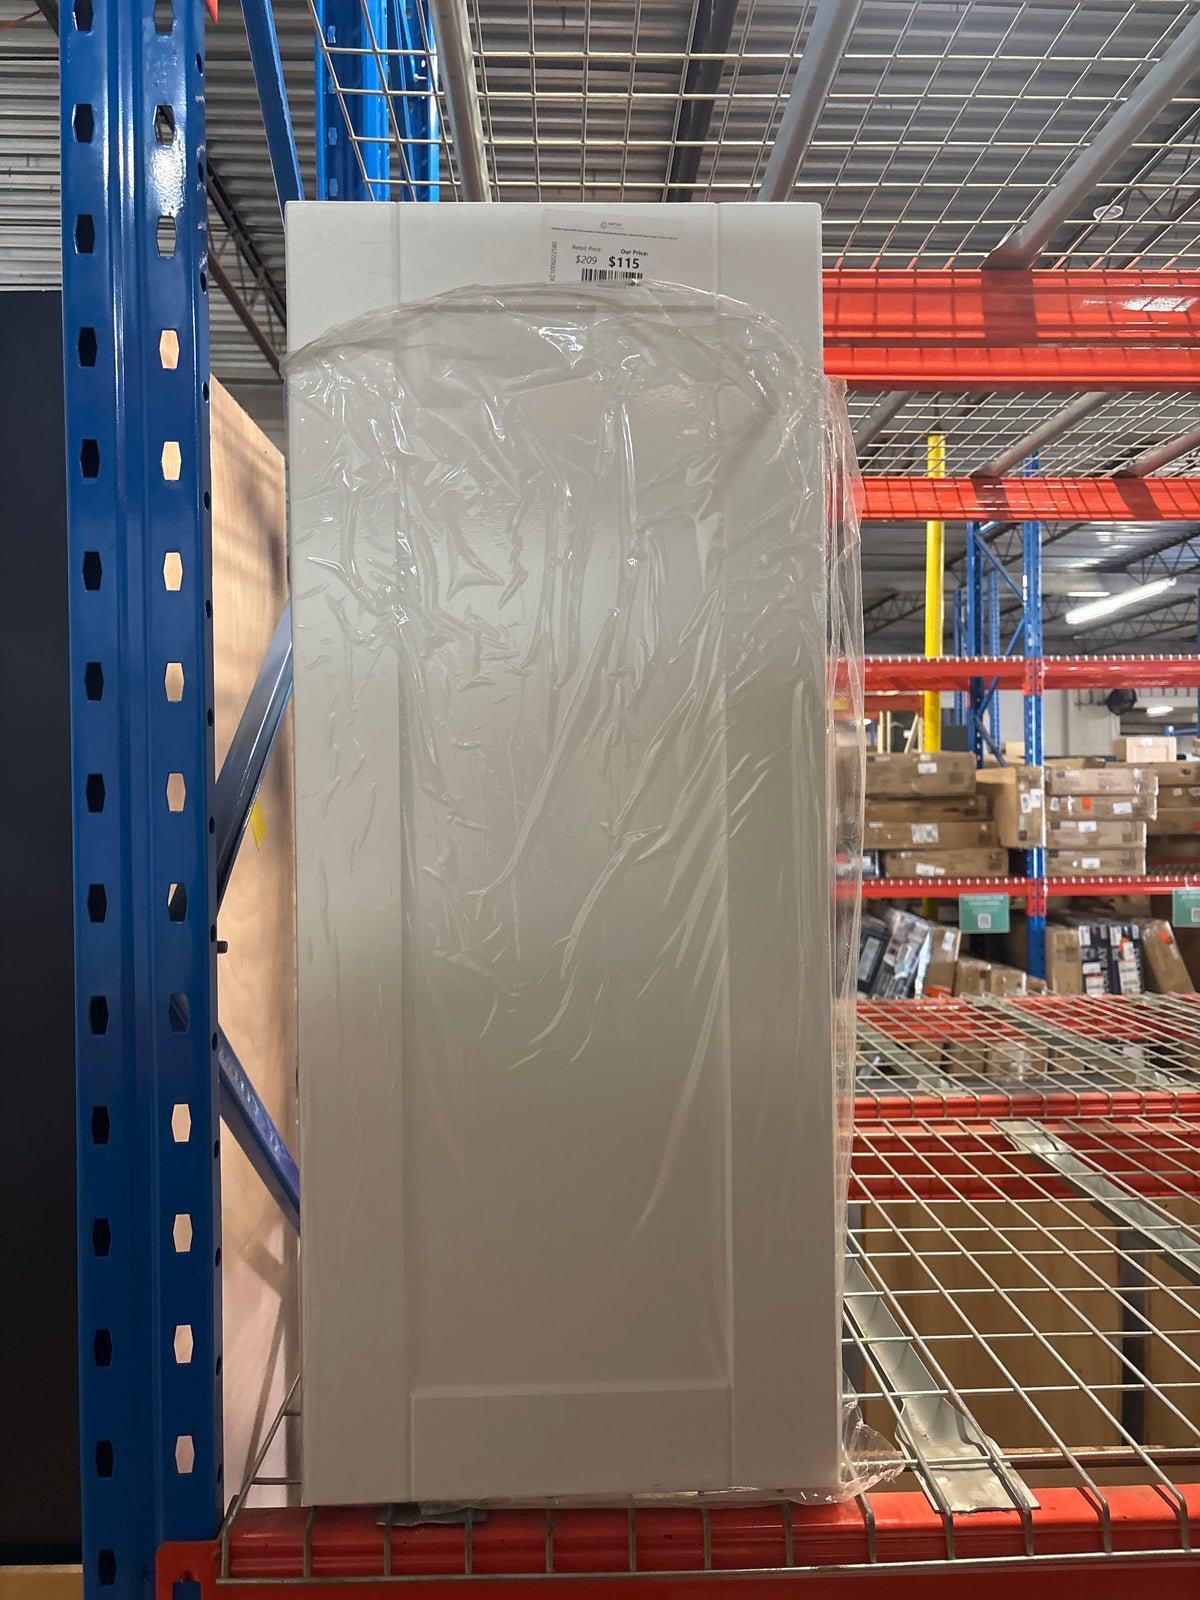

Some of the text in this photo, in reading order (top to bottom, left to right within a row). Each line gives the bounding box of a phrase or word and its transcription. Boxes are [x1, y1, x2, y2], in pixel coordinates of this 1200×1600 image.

[571, 244, 587, 252] Retail
[620, 248, 649, 257] Our Price:
[575, 254, 598, 265] $209
[608, 255, 640, 269] $115
